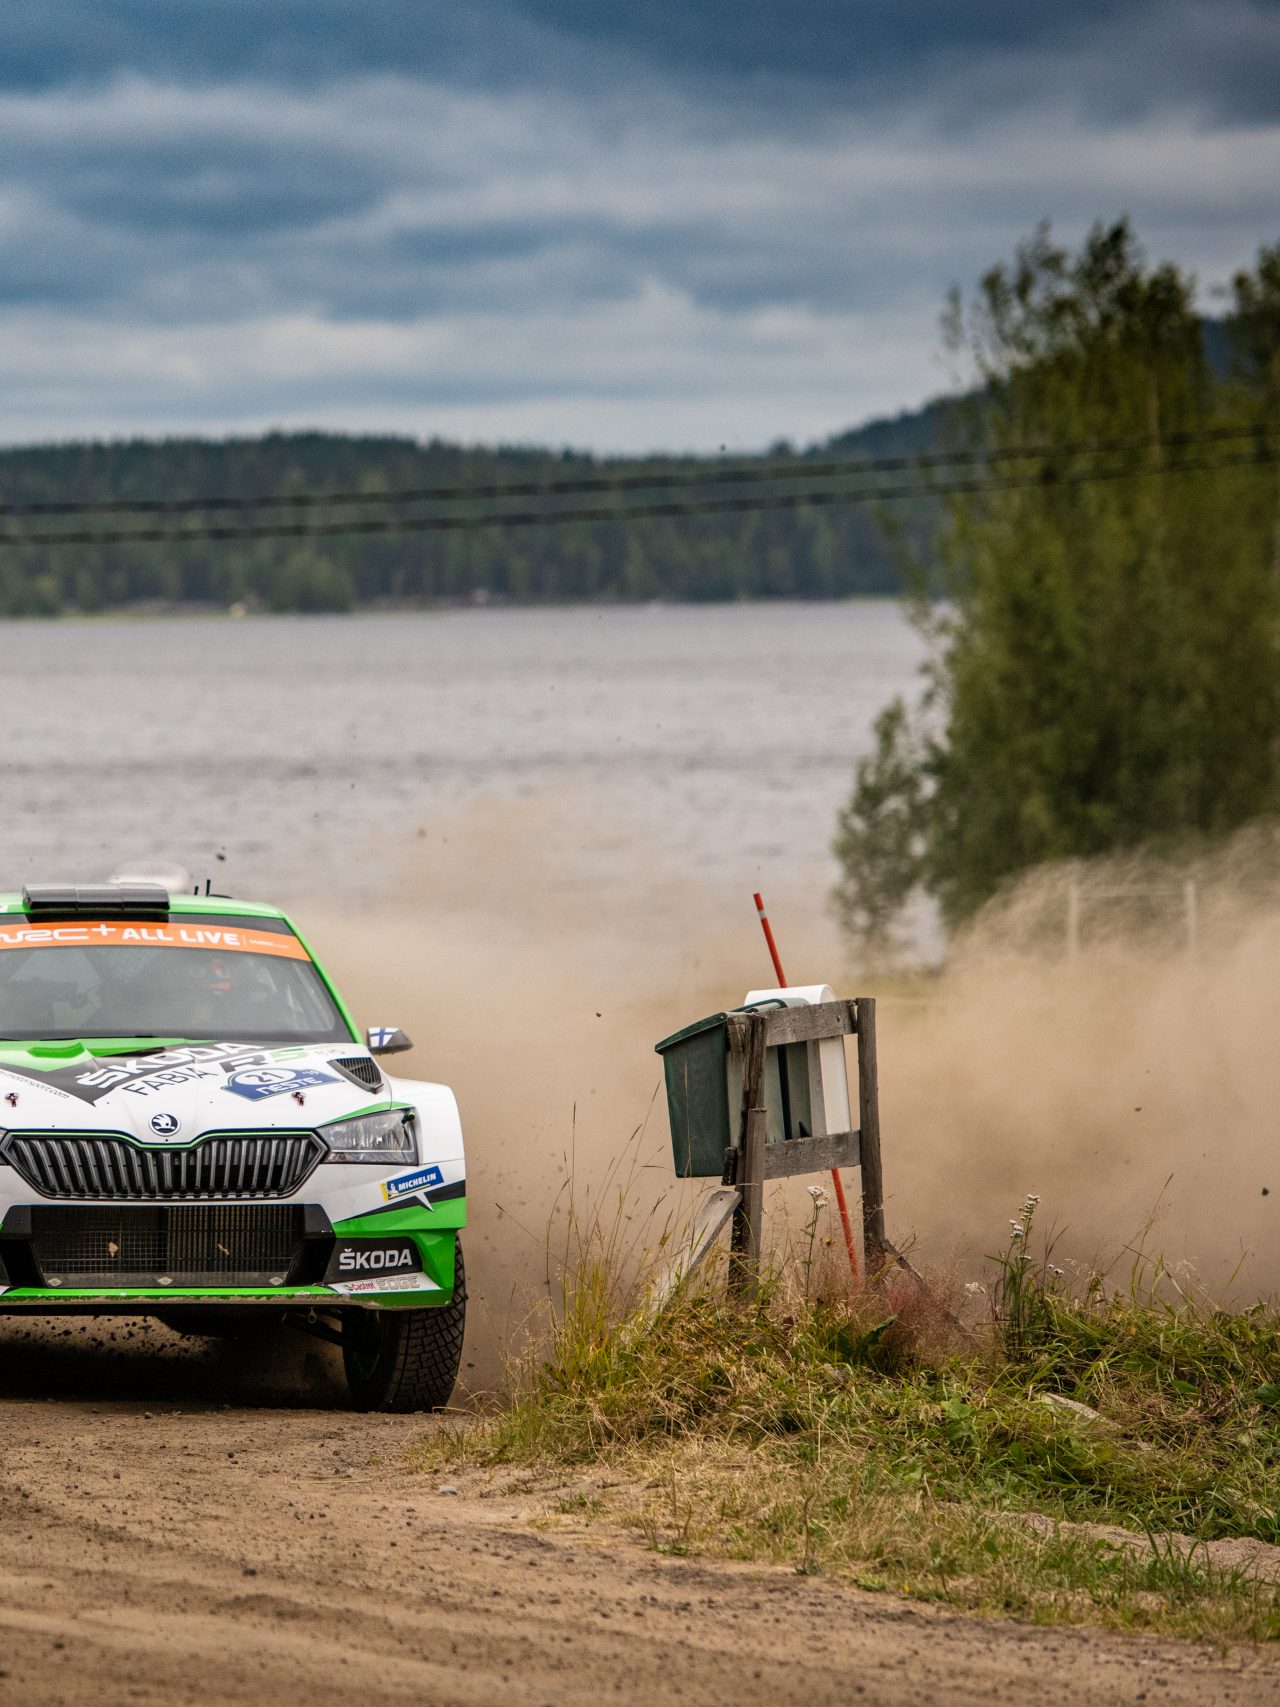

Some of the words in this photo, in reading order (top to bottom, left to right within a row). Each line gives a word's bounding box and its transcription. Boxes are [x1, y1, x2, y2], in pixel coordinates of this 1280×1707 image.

[122, 928, 173, 941] ALL
[180, 929, 241, 946] LIVE
[75, 1042, 265, 1088] ŠKODA
[122, 1067, 219, 1096] FABIA
[245, 1071, 284, 1083] 21
[398, 1172, 436, 1191] MICHELIN
[339, 1248, 413, 1270] ŠKODA
